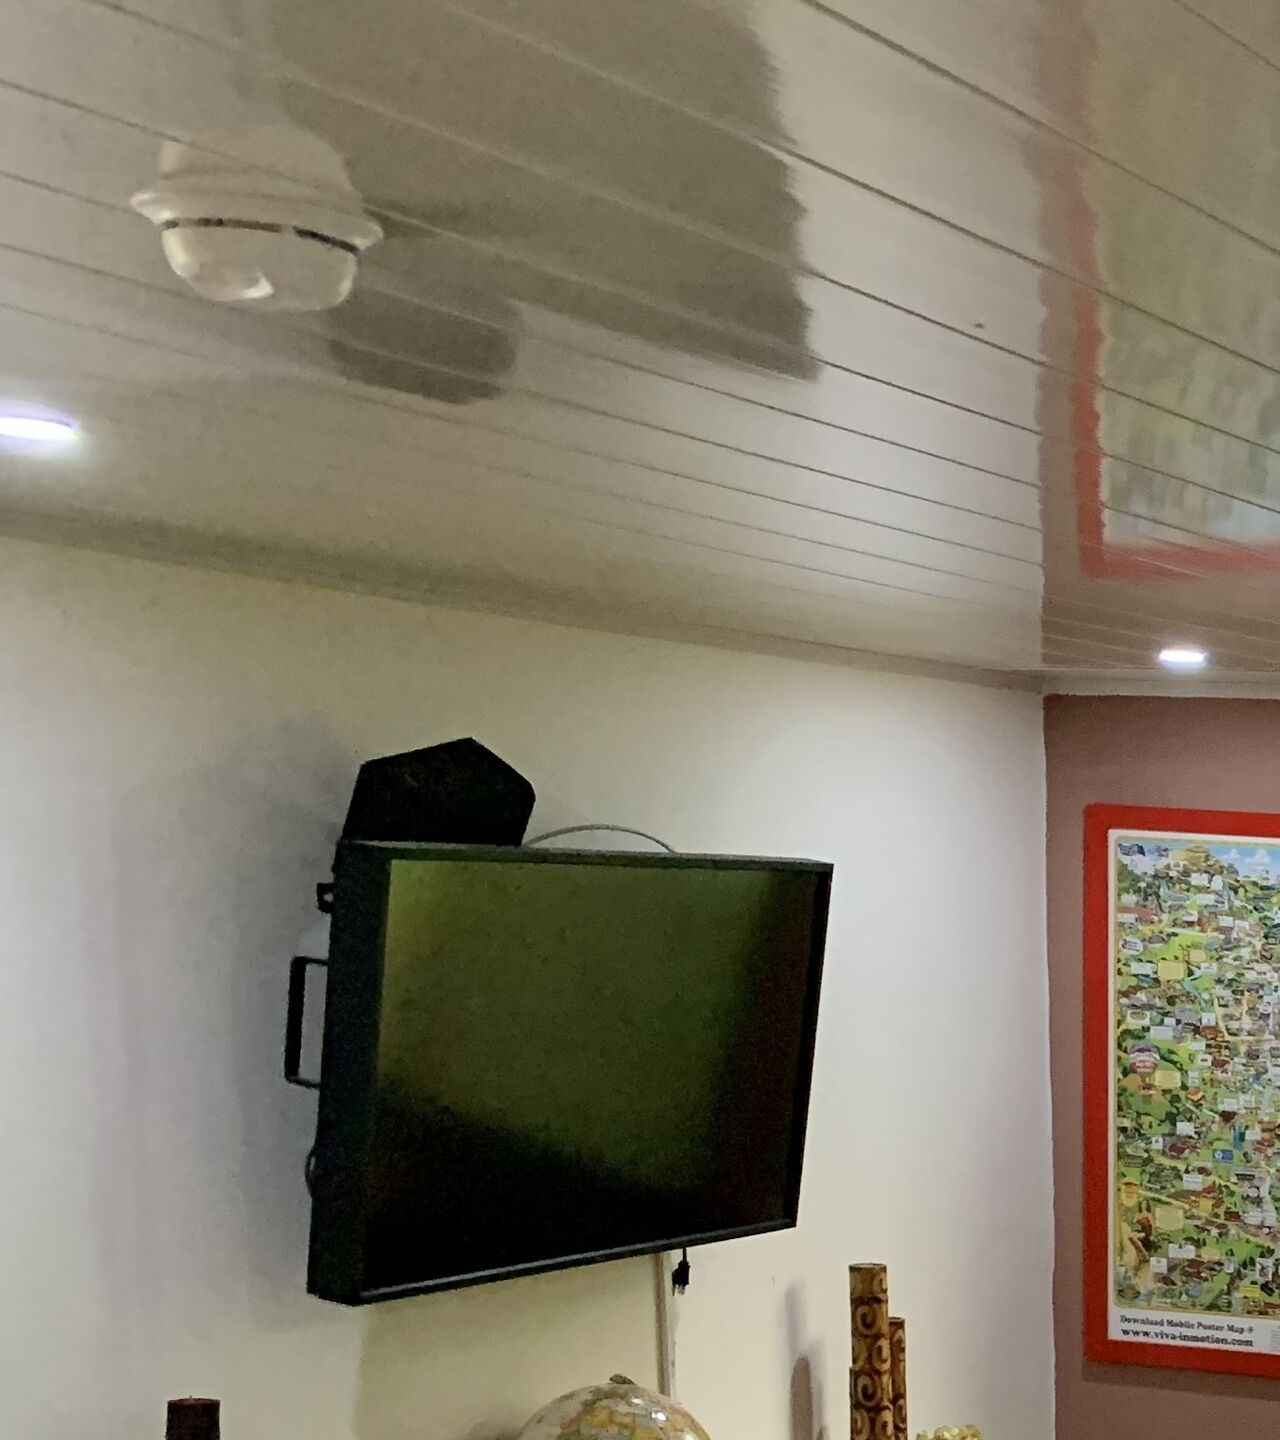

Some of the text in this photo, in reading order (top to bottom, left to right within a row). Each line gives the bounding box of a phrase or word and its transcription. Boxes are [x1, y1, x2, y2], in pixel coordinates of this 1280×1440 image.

[1120, 1315, 1164, 1326] Download
[1166, 1319, 1195, 1329] Mobile
[1197, 1322, 1224, 1332] Poster
[1226, 1324, 1245, 1334] Map
[1121, 1327, 1254, 1347] www.viva-inmotion.com
